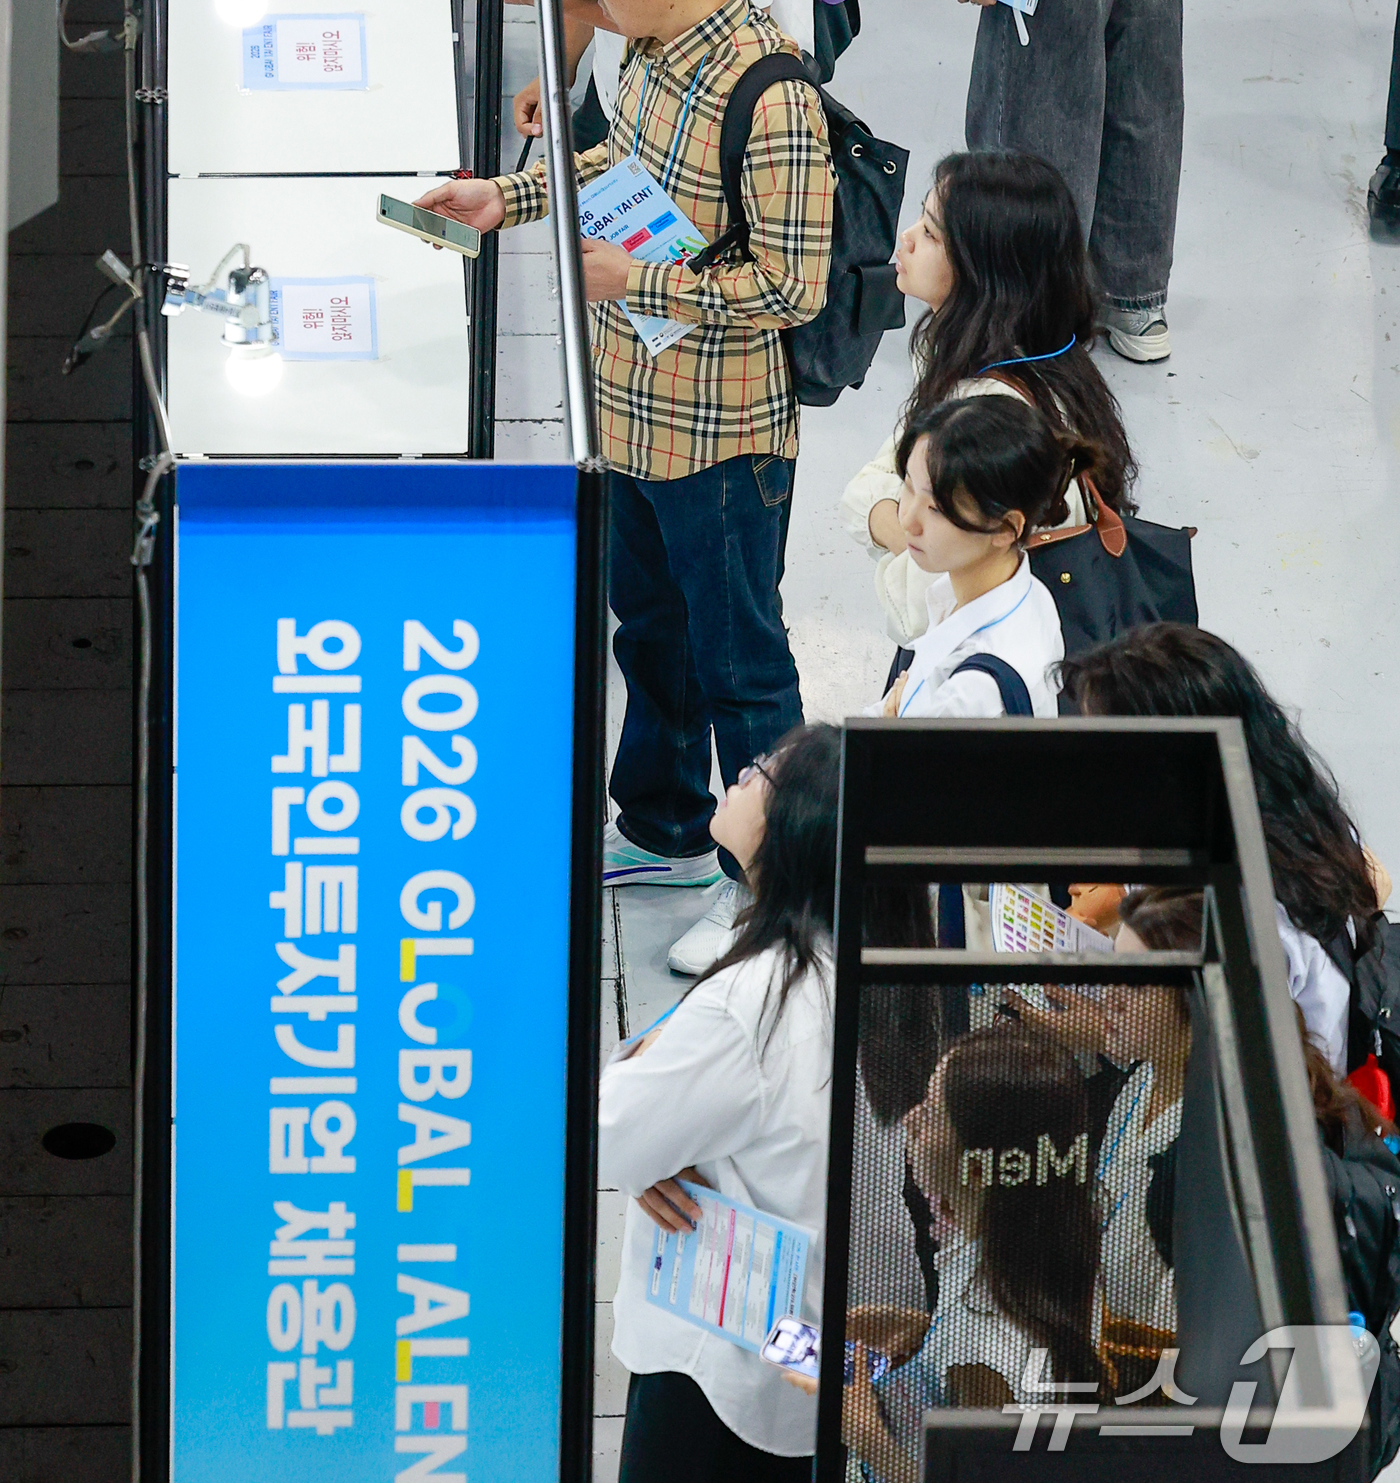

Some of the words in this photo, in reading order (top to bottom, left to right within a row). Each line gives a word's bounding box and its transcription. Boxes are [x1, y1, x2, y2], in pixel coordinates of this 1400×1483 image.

[295, 42, 316, 62] 위험!
[321, 30, 343, 73] 앉지마시오
[580, 210, 594, 226] 26
[581, 212, 618, 239] LOBAL
[614, 185, 654, 216] TALENT
[302, 308, 324, 329] 위험!
[330, 296, 353, 341] 앉지마시오
[401, 619, 480, 842] 2026
[269, 617, 362, 1174] 외국인투자기업
[396, 869, 476, 1212] GLOBAL
[266, 1200, 356, 1435] 채용관
